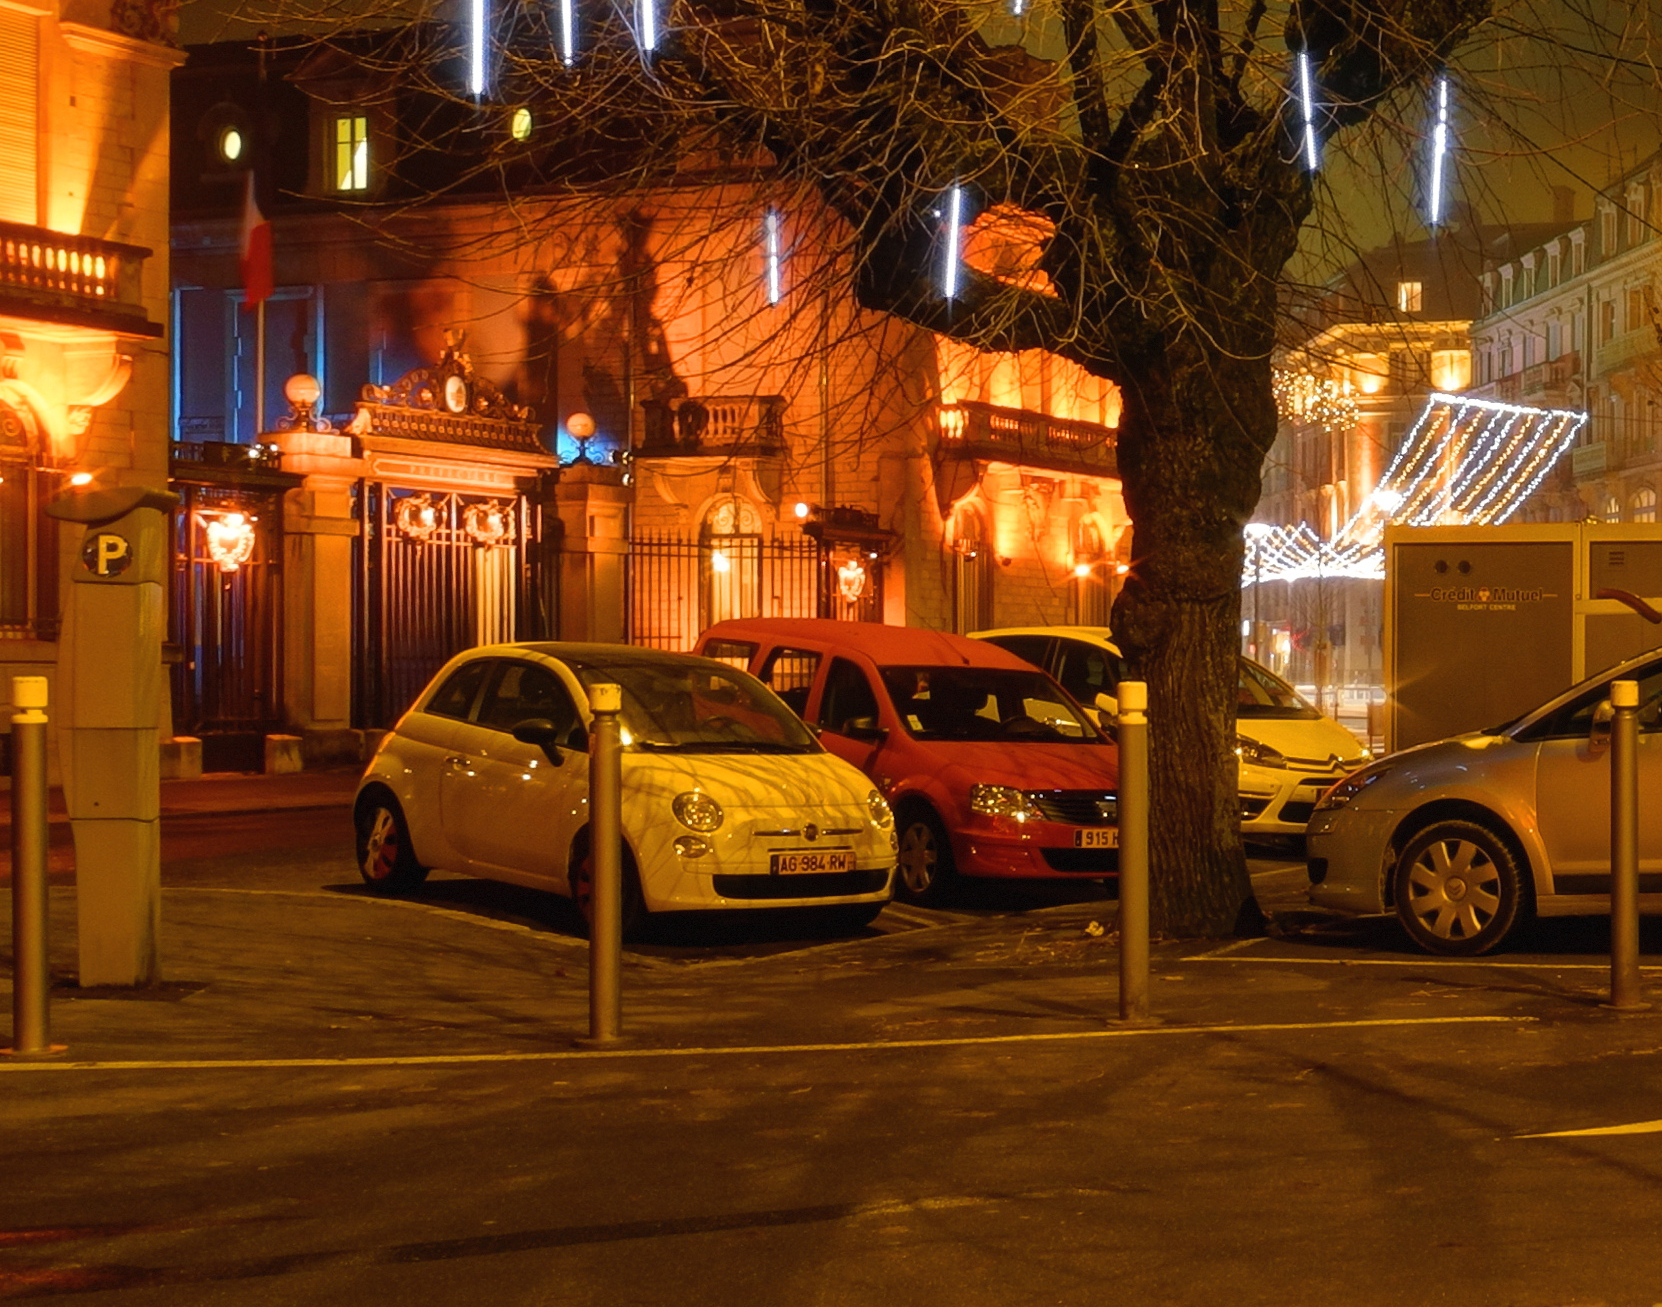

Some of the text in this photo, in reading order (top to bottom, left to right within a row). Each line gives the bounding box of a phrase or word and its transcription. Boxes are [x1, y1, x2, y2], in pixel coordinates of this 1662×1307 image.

[98, 535, 128, 574] P
[1430, 586, 1543, 601] Crédit Mutuel
[1456, 603, 1517, 611] BELFORT CENTRE
[1085, 831, 1109, 846] 915
